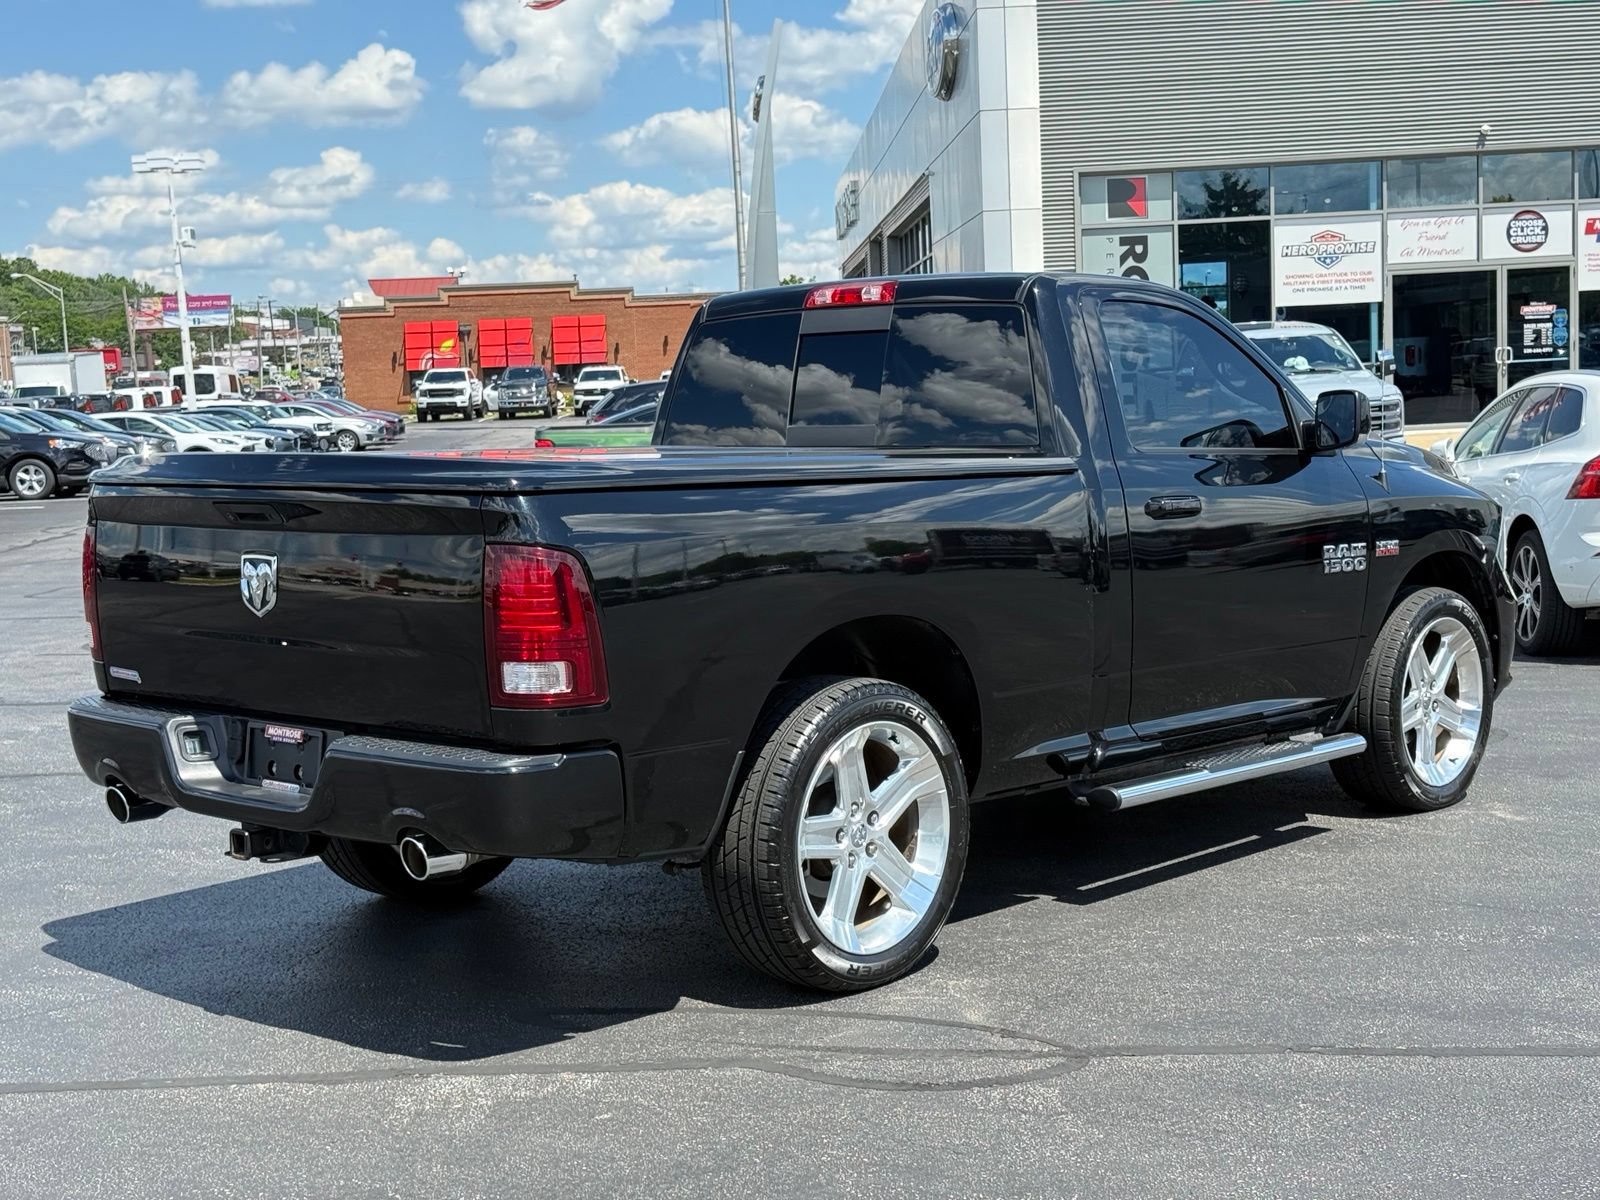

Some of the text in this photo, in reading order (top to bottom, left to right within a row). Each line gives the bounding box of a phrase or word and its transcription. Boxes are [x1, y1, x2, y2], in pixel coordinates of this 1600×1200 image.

[1417, 231, 1449, 241] Friend
[1509, 227, 1545, 236] CLICK.
[1510, 235, 1545, 244] CRUISE!
[1281, 241, 1376, 257] HERO PROMISE
[1323, 542, 1367, 559] RAM
[1323, 557, 1367, 574] 1500
[267, 727, 302, 739] MONTROSE
